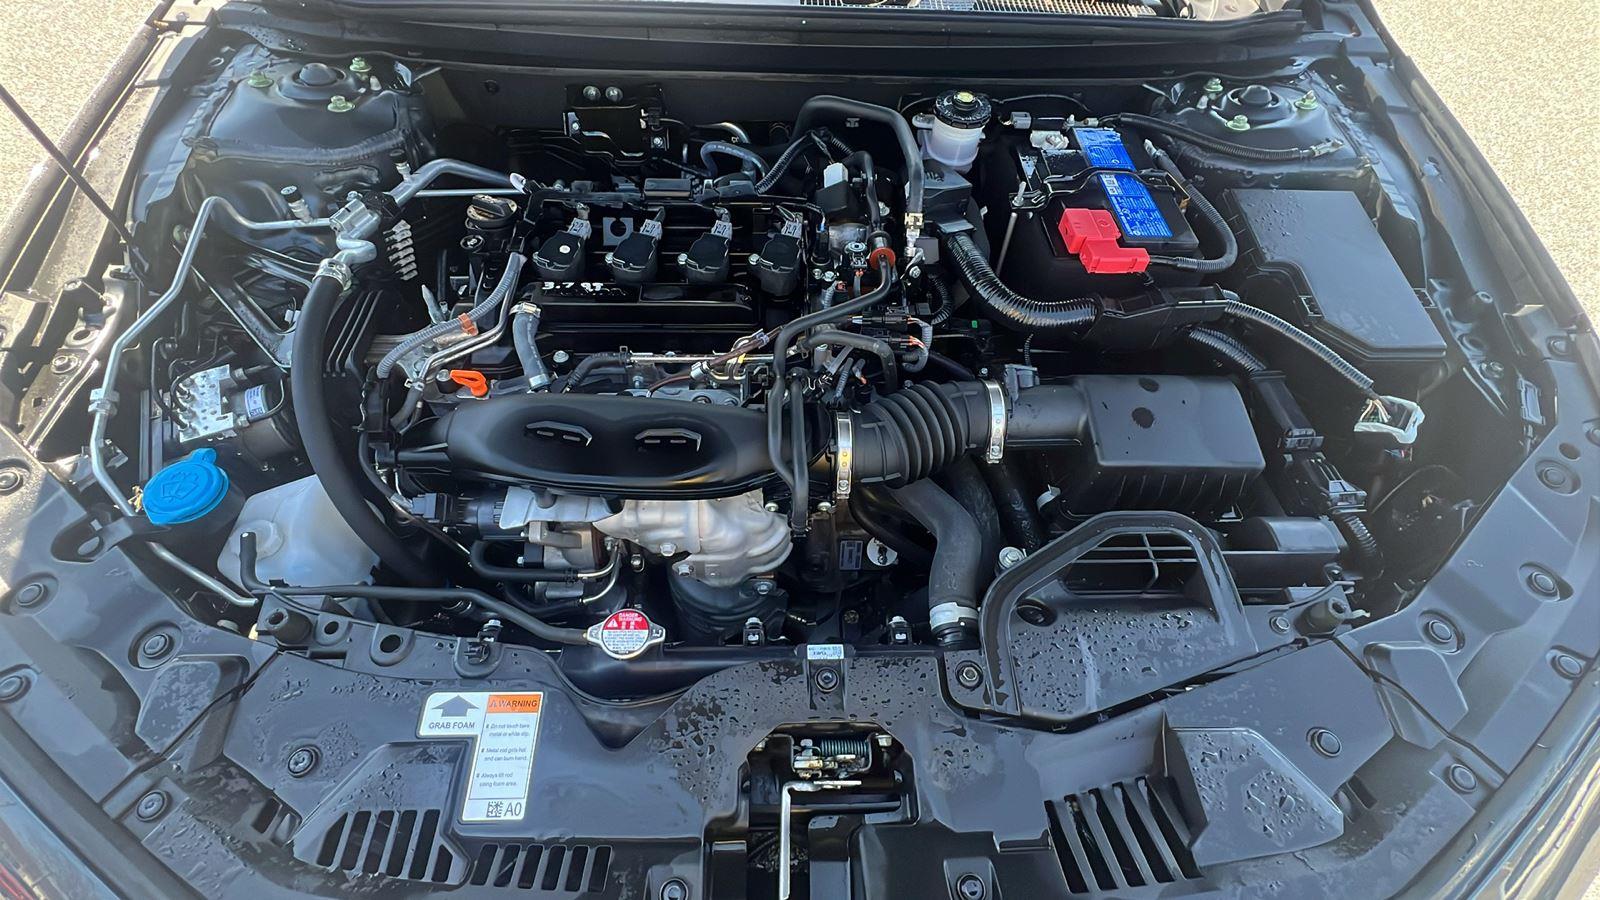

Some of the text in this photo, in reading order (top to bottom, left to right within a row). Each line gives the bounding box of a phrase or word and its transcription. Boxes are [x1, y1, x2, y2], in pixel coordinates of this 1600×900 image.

[498, 700, 538, 708] WARNING
[428, 721, 475, 730] GRAB FOAM
[504, 802, 523, 817] A0
